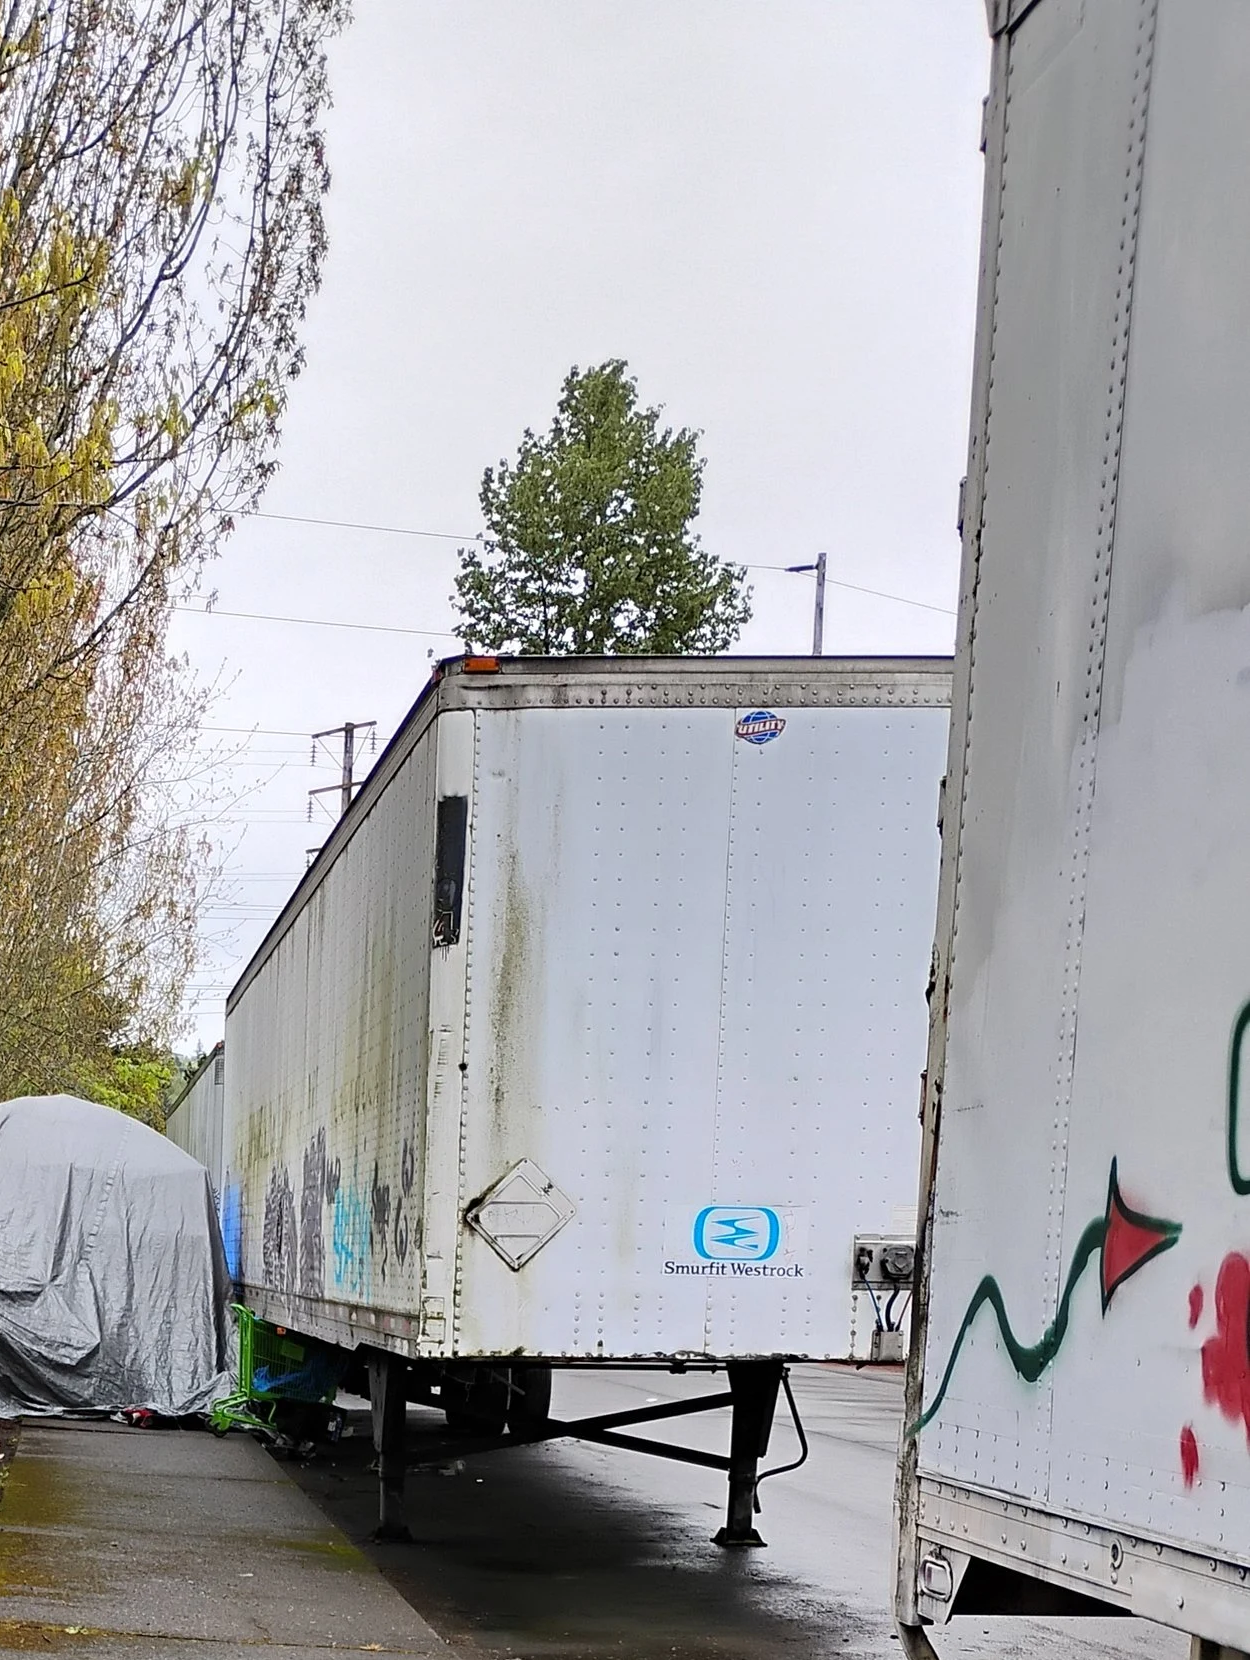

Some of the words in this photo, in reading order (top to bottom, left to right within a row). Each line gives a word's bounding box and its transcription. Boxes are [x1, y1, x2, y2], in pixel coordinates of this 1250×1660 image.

[737, 720, 784, 734] UTILITY
[664, 1261, 726, 1275] Smurfit
[730, 1262, 803, 1277] Westrock
